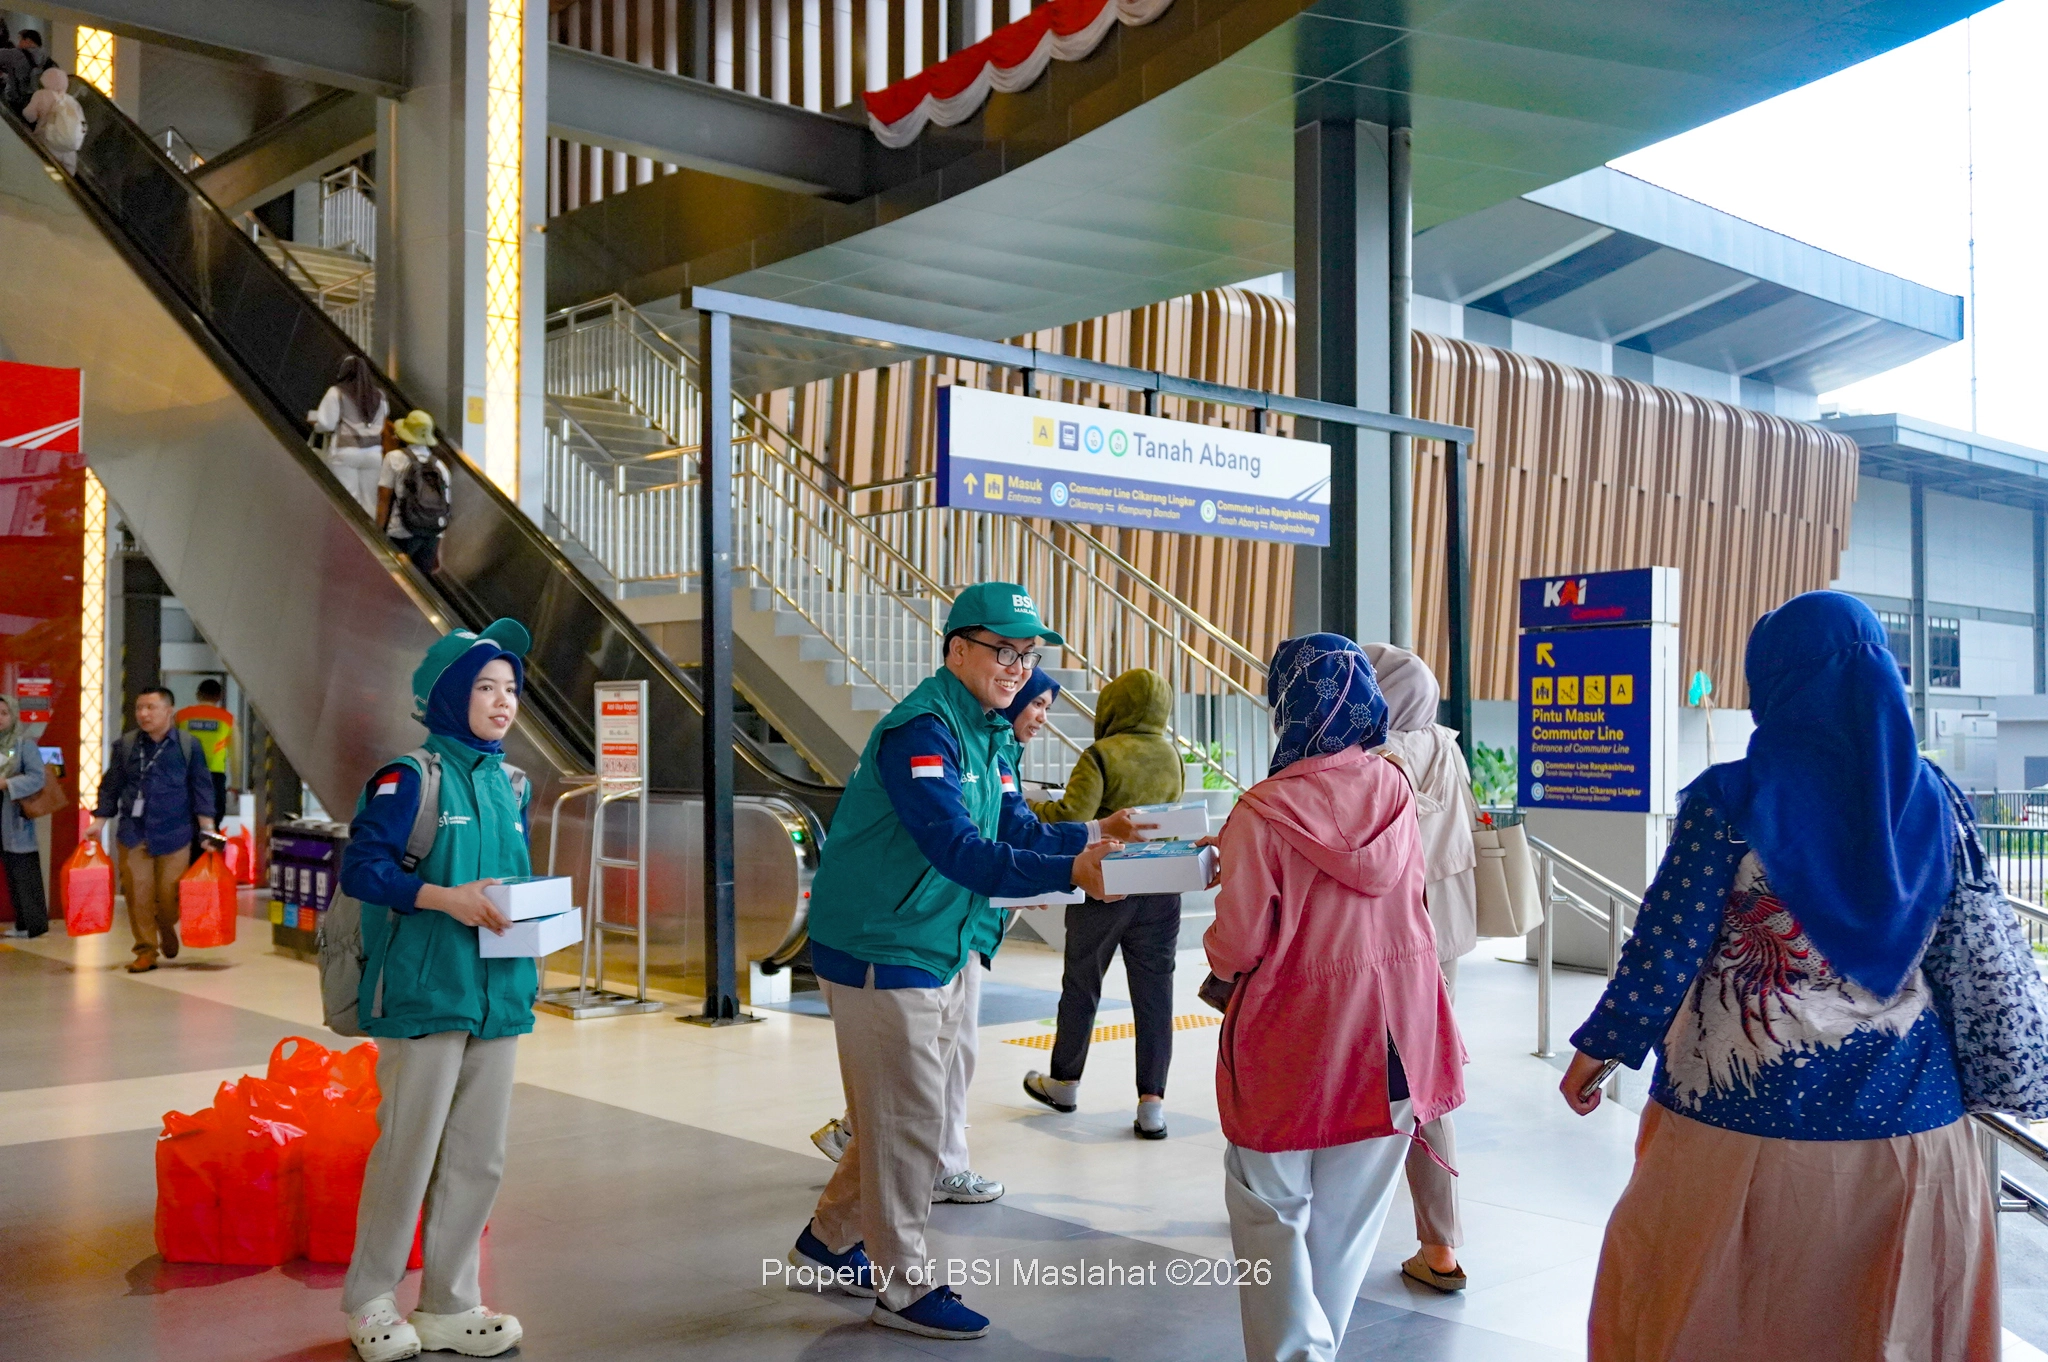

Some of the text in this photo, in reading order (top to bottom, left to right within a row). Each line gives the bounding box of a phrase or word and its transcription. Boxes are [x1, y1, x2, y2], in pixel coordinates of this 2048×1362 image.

[1038, 425, 1048, 439] A
[1133, 431, 1261, 479] Tanah Abang
[1007, 475, 1043, 491] Masuk
[1006, 491, 1042, 504] Entrance
[1069, 482, 1196, 508] Commuter Line Cikarang Lingkar
[1068, 497, 1103, 513] Cikarang
[1117, 503, 1152, 518] Kampung
[1217, 500, 1320, 524] Commuter Line Rangkasbitung
[1217, 514, 1238, 525] Tanah
[1238, 517, 1259, 531] Abang
[1012, 594, 1034, 610] BSI
[1616, 683, 1626, 697] A
[1532, 707, 1605, 723] Pintu Masuk
[1532, 725, 1625, 741] Commuter Line
[1532, 742, 1630, 754] Entrance of Commuter Line
[1545, 761, 1576, 770] Commuter
[1576, 762, 1590, 771] Line
[1545, 784, 1576, 793] Commuter
[1576, 785, 1589, 794] Line
[1589, 785, 1617, 797] Cikarang
[949, 1176, 964, 1188] N
